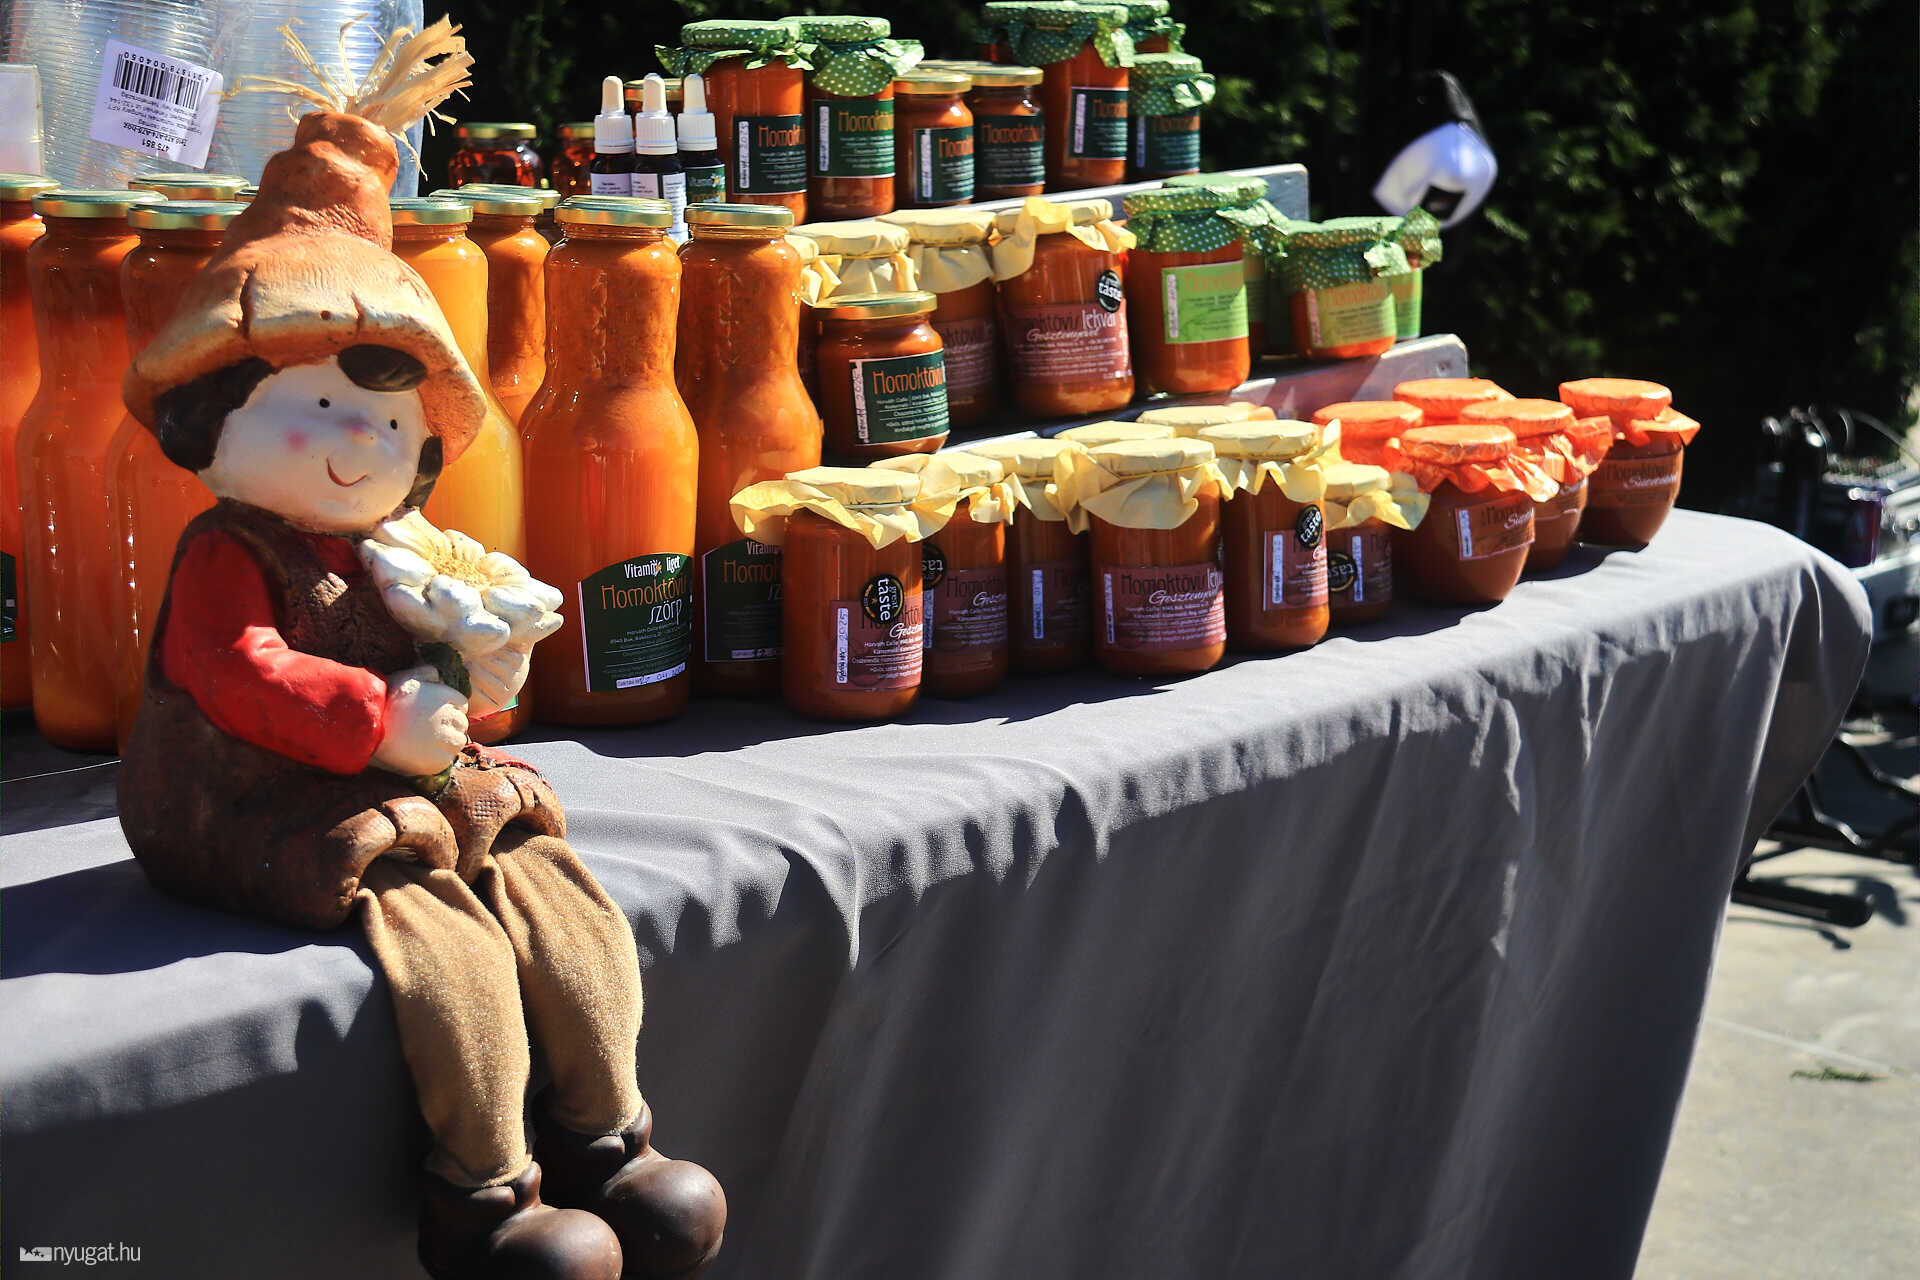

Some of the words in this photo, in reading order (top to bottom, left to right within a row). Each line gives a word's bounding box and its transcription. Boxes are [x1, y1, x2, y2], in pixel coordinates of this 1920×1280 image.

[142, 138, 156, 149] 851
[648, 598, 682, 625] szörp
[877, 577, 891, 621] taste
